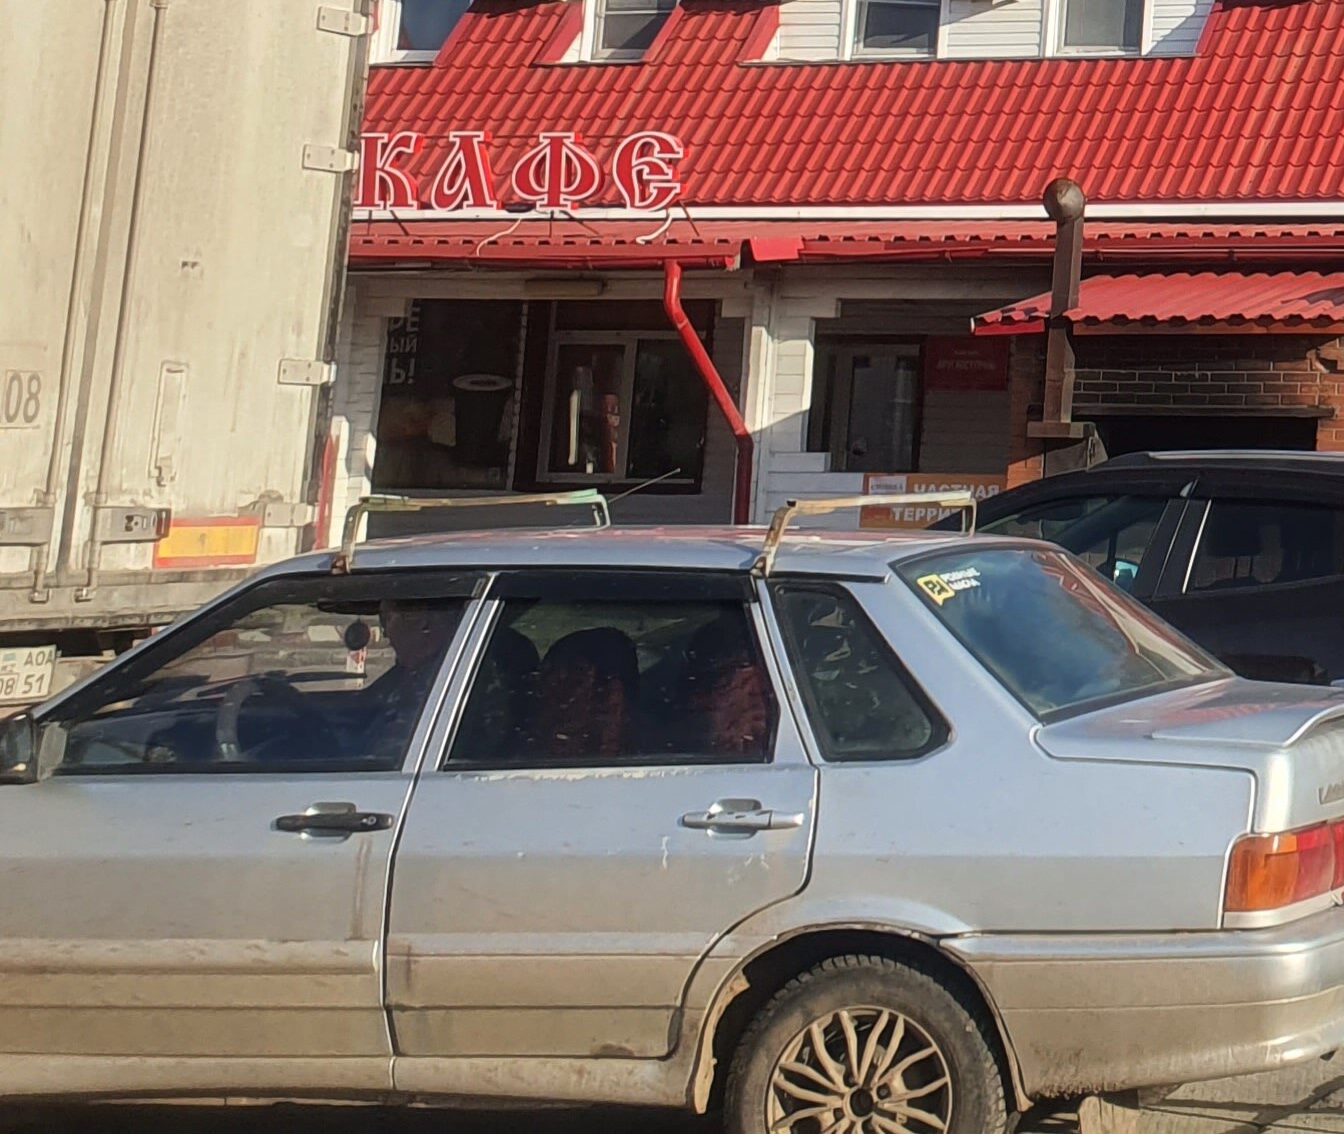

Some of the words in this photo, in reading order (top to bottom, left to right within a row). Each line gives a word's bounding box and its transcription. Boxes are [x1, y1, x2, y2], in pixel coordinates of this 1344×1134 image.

[4, 372, 42, 424] 08
[891, 507, 961, 522] ТЕРРИ
[22, 673, 45, 695] 51
